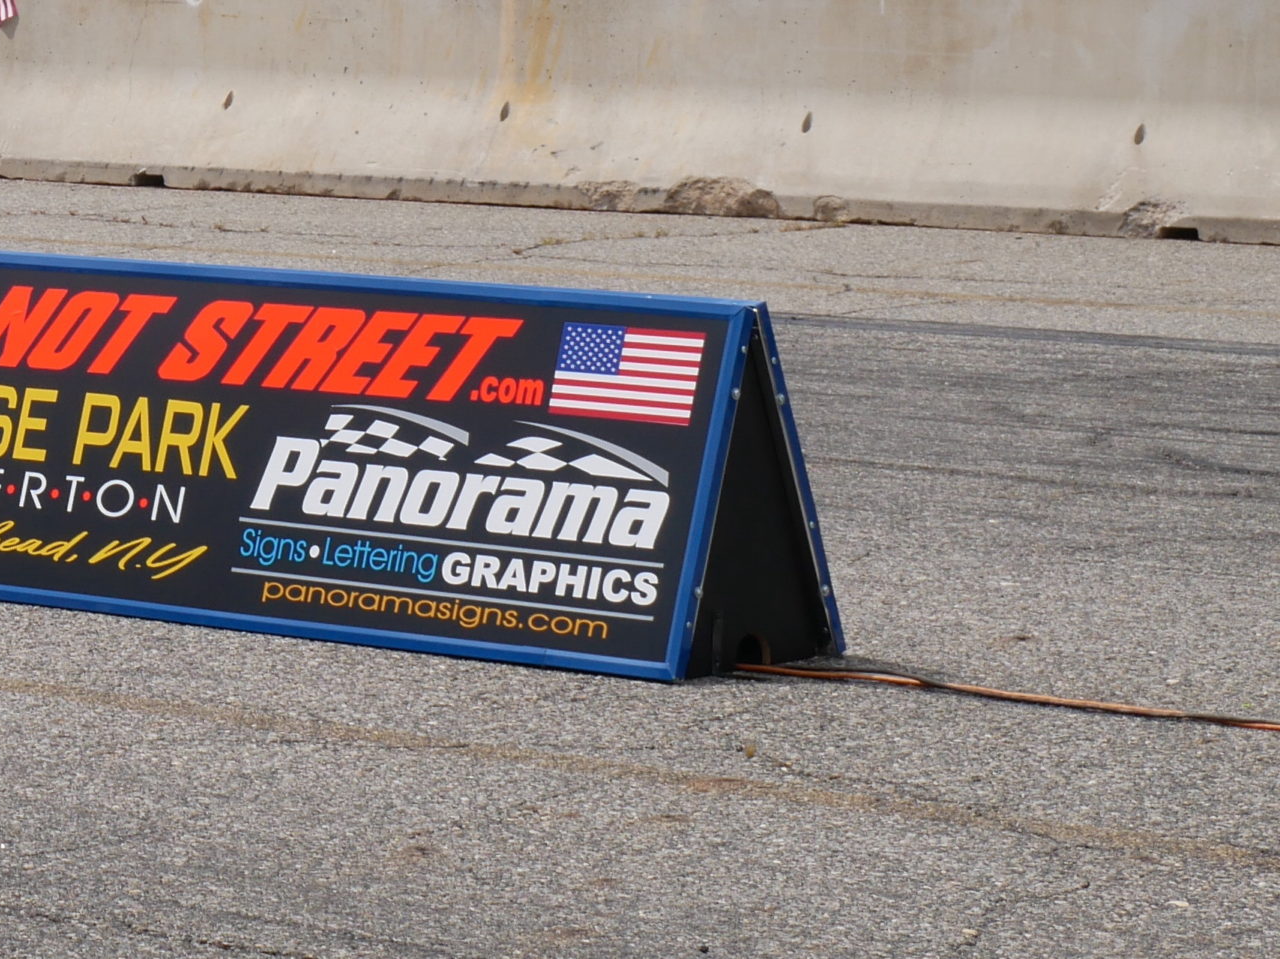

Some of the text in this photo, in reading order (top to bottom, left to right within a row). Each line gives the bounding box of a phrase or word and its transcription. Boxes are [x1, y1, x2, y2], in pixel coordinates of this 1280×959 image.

[72, 392, 250, 480] PARK
[249, 436, 671, 550] Panorama
[239, 527, 659, 606] Signs Lettering GRAPHICS
[260, 580, 610, 639] panoramasigns.com
